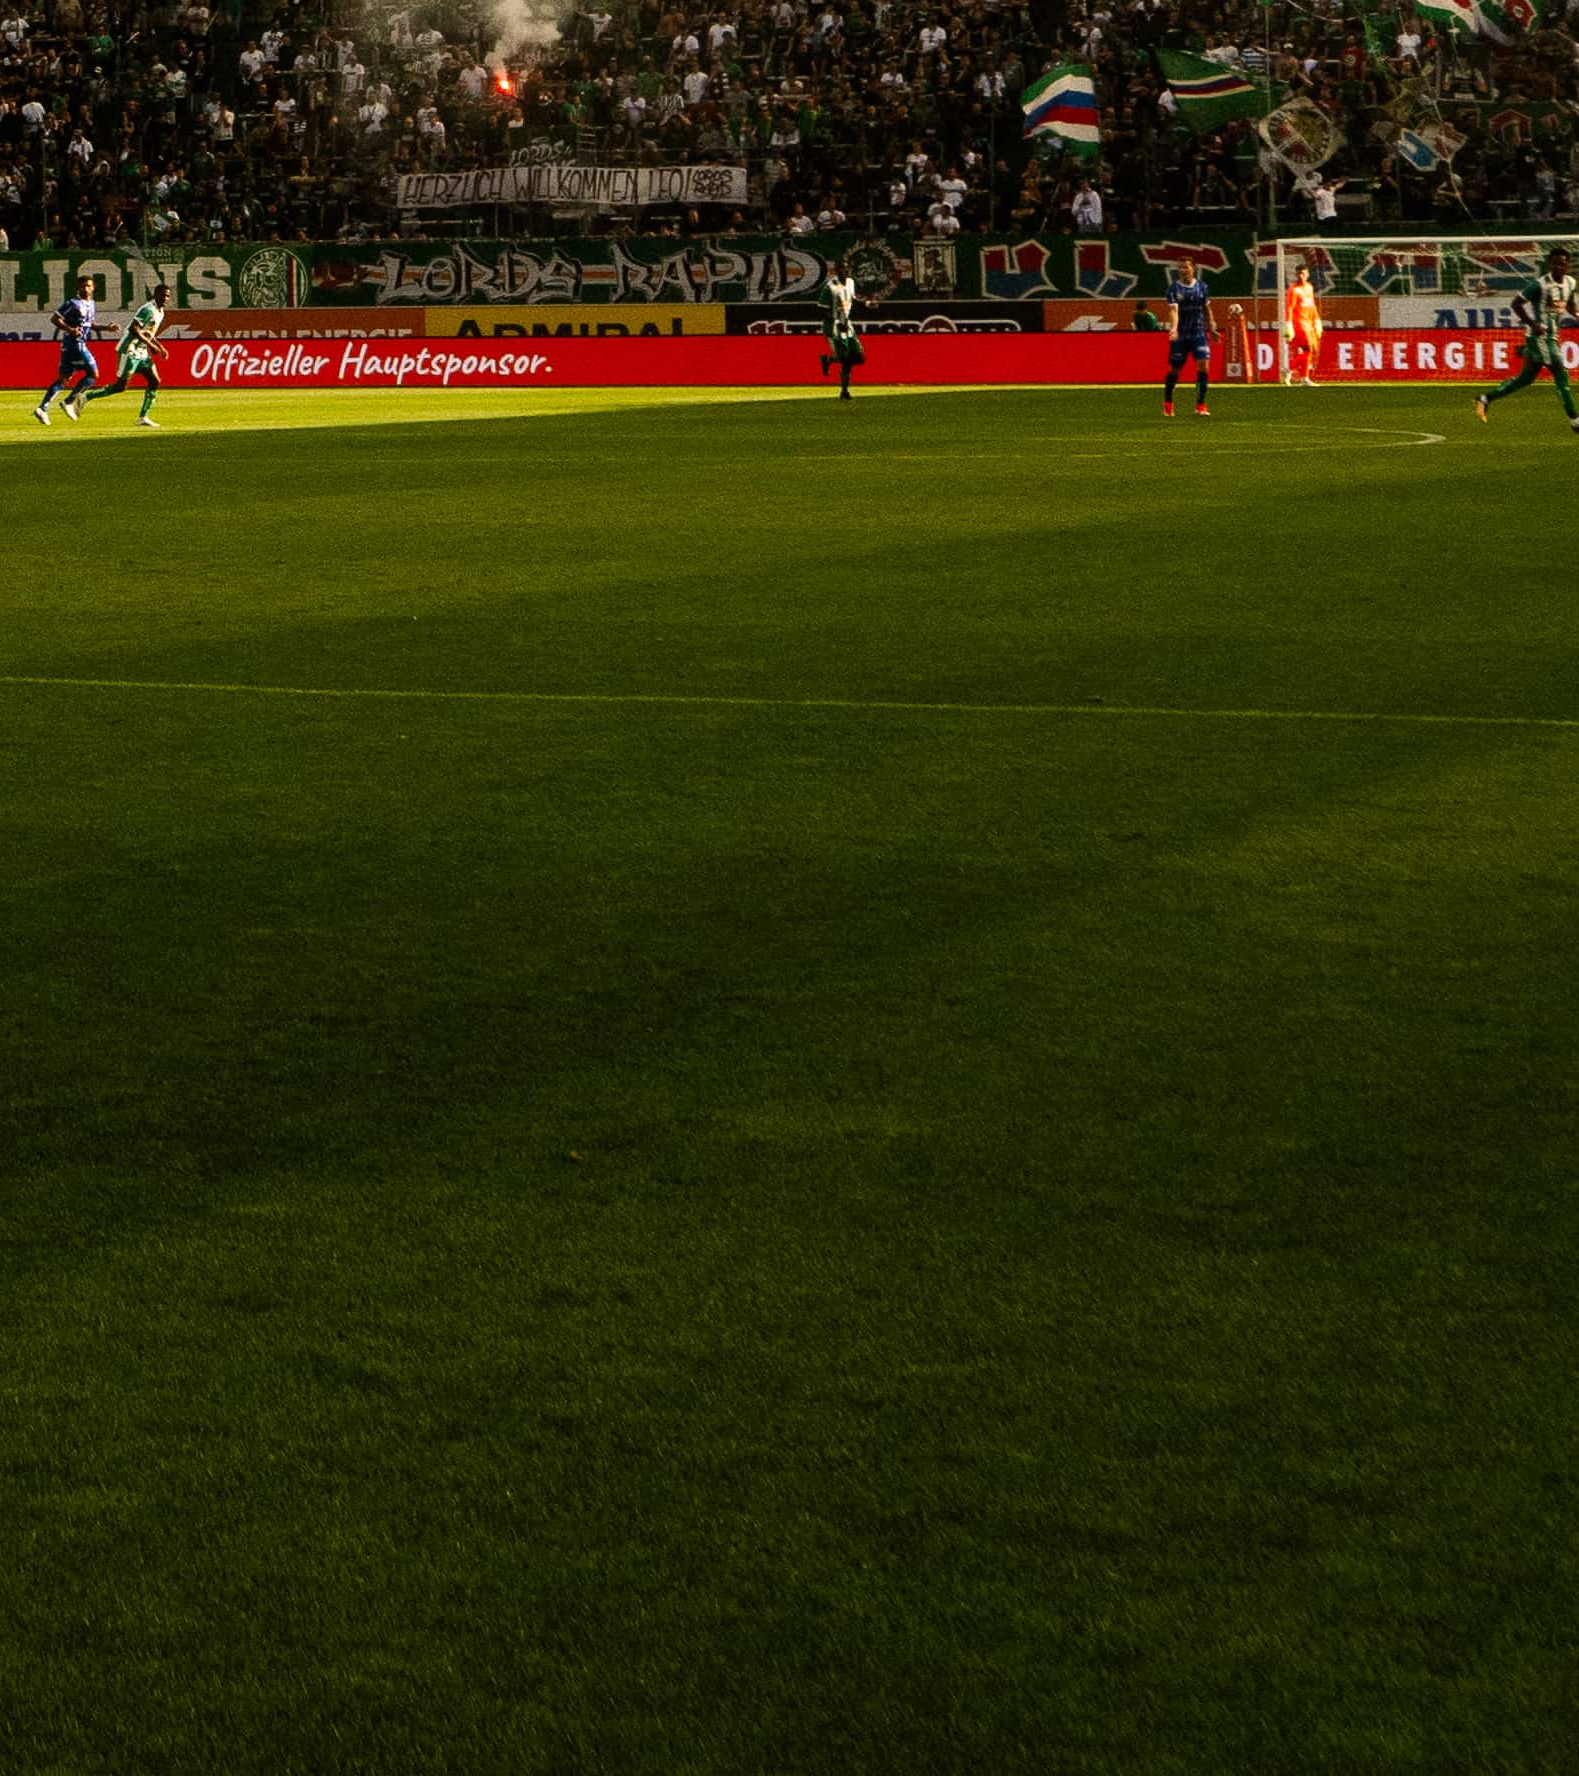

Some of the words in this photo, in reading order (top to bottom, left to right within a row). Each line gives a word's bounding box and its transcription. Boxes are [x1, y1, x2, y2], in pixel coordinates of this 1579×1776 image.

[404, 168, 505, 205] HERZLICH
[515, 166, 639, 203] WILLKOMMEN
[375, 241, 582, 305] LORDS
[610, 237, 828, 305] RAPID
[190, 343, 330, 380] Offizieller
[338, 341, 553, 385] Hauptsponsor.
[1337, 342, 1510, 371] ENERGIE
